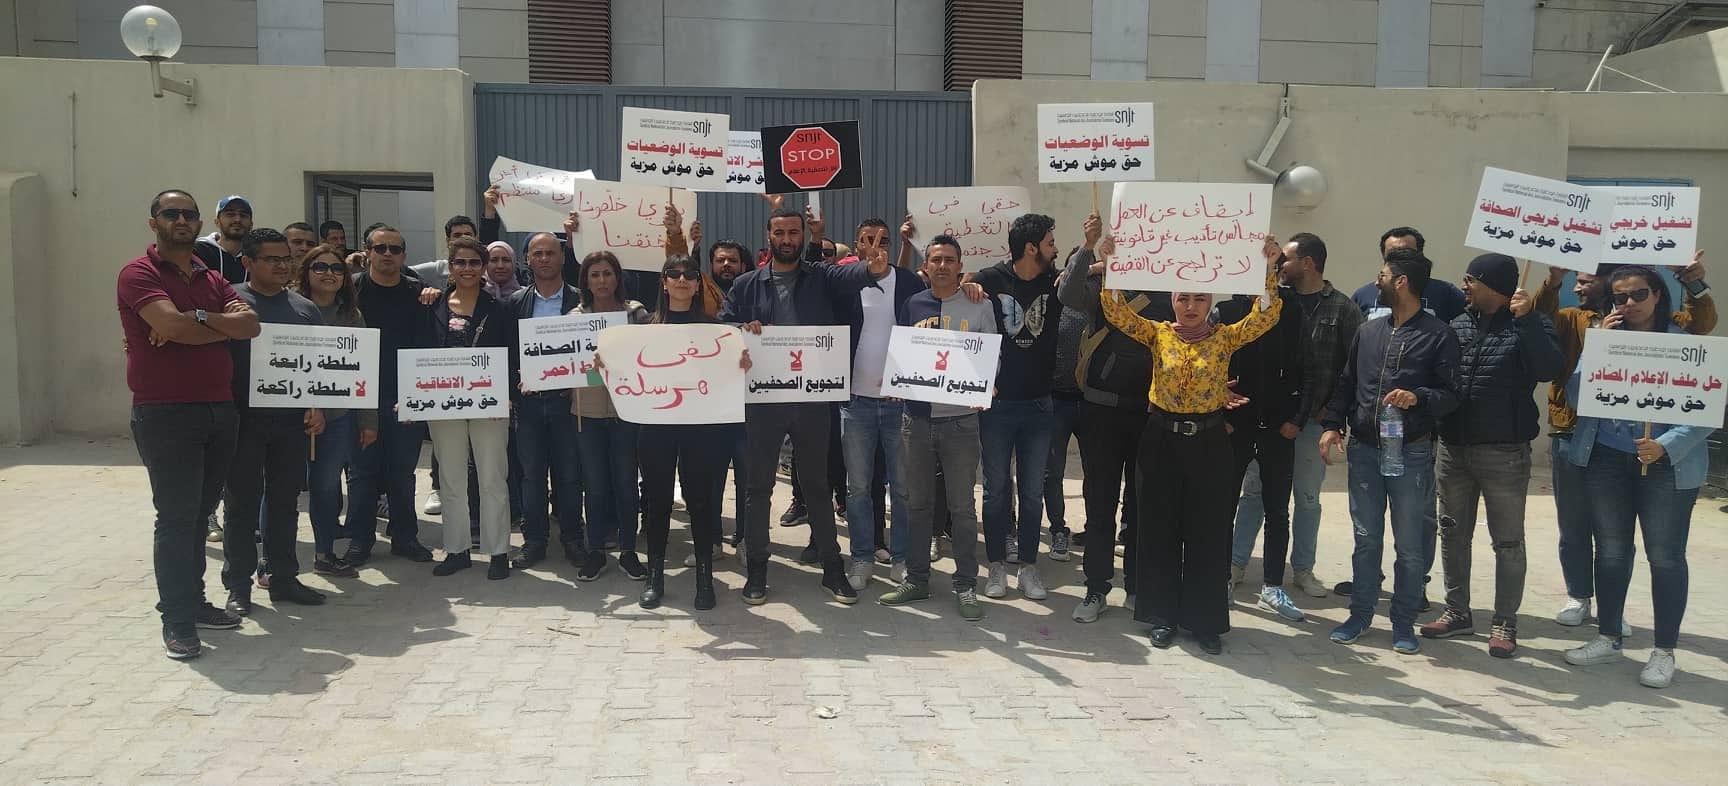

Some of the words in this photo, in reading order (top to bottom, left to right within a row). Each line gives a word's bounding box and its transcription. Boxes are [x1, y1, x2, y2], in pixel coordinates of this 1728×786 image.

[1114, 107, 1136, 127] snjt
[692, 119, 712, 138] snjt
[627, 139, 686, 157] الوضعيات
[688, 142, 723, 159] تسوية
[750, 139, 763, 149] sn
[1045, 135, 1108, 151] الوضعيات
[1112, 134, 1150, 151] تسوية
[746, 156, 764, 168] شر
[788, 148, 835, 162] STOP
[1049, 156, 1079, 172] مزية
[1084, 155, 1117, 172] موش
[1121, 154, 1142, 171] حق
[631, 157, 657, 173] مزية
[662, 160, 691, 175] موش
[696, 162, 714, 178] حق
[928, 196, 960, 216] في
[981, 197, 1020, 218] حقي
[1480, 198, 1521, 219] الصحافة
[1566, 193, 1591, 213] snjt
[1651, 192, 1676, 211] snjt
[1109, 202, 1147, 231] العمل
[1148, 206, 1177, 224] عن
[1522, 212, 1559, 228] خريجي
[1610, 215, 1648, 232] خريجي
[1652, 215, 1692, 231] تشغيل
[1111, 223, 1154, 248] قانونية
[1174, 223, 1216, 244] تأديب
[1219, 219, 1265, 245] مجالس
[1483, 220, 1514, 240] مزية
[1563, 218, 1602, 236] تشغيل
[1146, 229, 1173, 255] غير
[1520, 229, 1555, 248] موش
[1560, 237, 1583, 253] حق
[1612, 235, 1648, 250] موش
[1653, 234, 1676, 251] حق
[1109, 254, 1150, 274] القضية
[1151, 257, 1176, 275] عن
[1226, 255, 1251, 276] لا
[337, 333, 359, 353] snjt
[523, 338, 581, 357] الصحافة
[637, 332, 732, 369] كفى
[815, 332, 835, 351] snjt
[963, 336, 984, 354] snjt
[269, 352, 312, 373] رابعة
[317, 354, 360, 371] سلطة
[471, 352, 490, 370] snjt
[790, 350, 803, 371] لا
[935, 350, 950, 371] لا
[1680, 343, 1708, 367] snjt
[539, 357, 575, 380] أحمر
[307, 380, 350, 397] سلطة
[355, 380, 366, 397] لا
[415, 375, 464, 393] الاتفاقية
[467, 375, 493, 391] نشر
[749, 376, 803, 394] الصحفيين
[806, 376, 845, 393] لتجويع
[890, 371, 945, 388] الصحفيين
[947, 378, 988, 393] لتجويع
[1630, 370, 1669, 389] الإعلام
[1672, 372, 1698, 387] ملف
[1702, 375, 1722, 391] حل
[257, 379, 302, 399] راكعة
[1595, 388, 1630, 406] مزية
[406, 394, 435, 411] مزية
[441, 394, 473, 410] موش
[478, 394, 498, 409] حق
[1636, 392, 1675, 410] موش
[1681, 395, 1706, 412] حق
